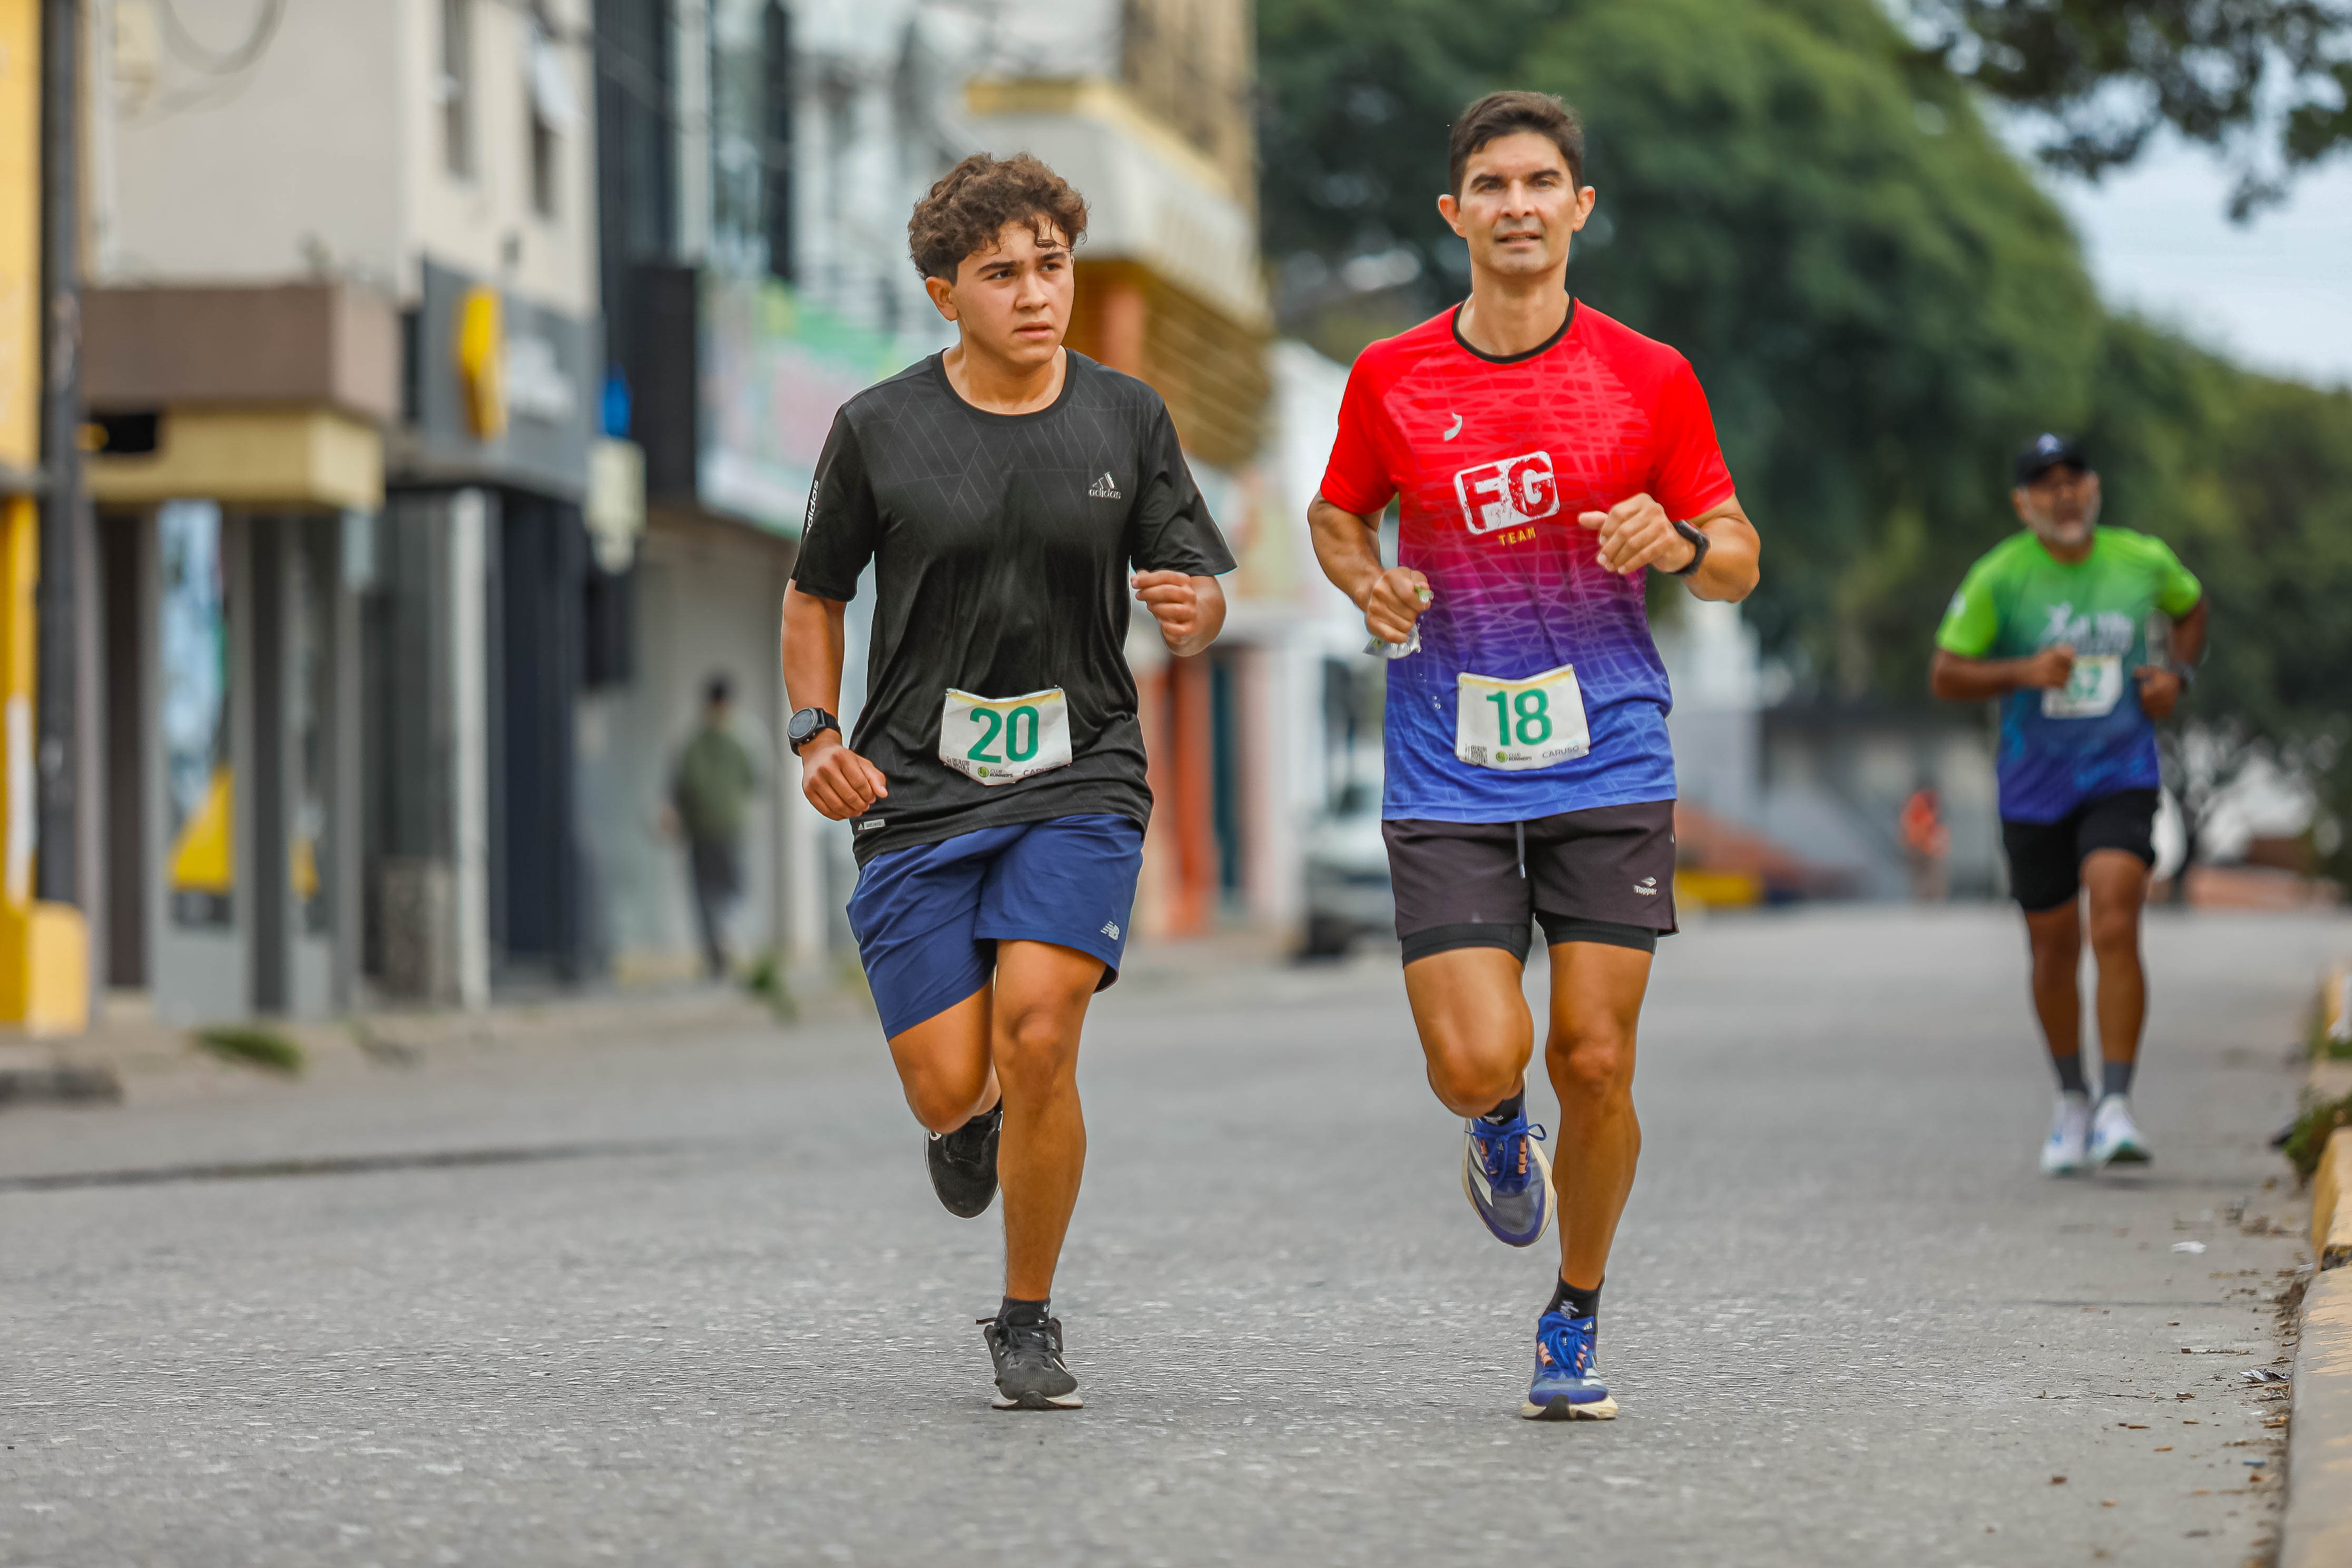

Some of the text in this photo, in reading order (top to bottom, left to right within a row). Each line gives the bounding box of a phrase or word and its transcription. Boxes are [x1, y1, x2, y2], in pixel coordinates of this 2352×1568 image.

[1089, 488, 1121, 499] adidas
[1461, 457, 1555, 530] FG
[1498, 526, 1536, 546] TEAM
[1486, 688, 1553, 746] 18
[967, 705, 1040, 763] 20
[1542, 745, 1580, 758] CARUSO
[1634, 885, 1657, 896] Topper
